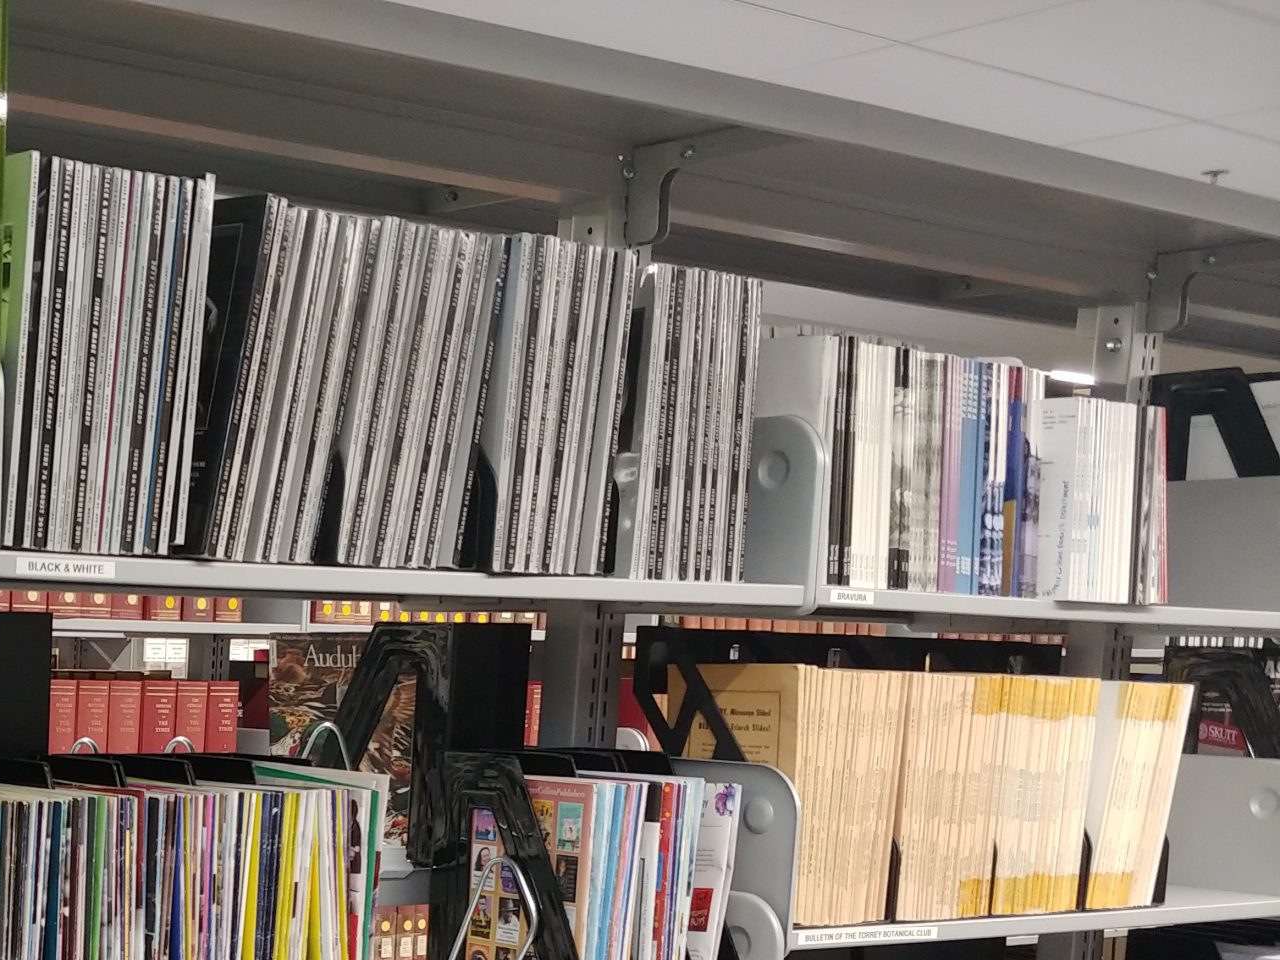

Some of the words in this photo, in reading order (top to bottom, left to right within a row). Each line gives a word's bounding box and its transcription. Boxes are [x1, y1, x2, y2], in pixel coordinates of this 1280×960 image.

[64, 165, 72, 191] BLACK
[103, 174, 112, 198] BLACK
[60, 201, 70, 226] WHITE
[100, 208, 108, 234] WHITE
[57, 229, 67, 272] MAGAZINE
[96, 236, 106, 278] MAGAZINE
[54, 288, 62, 308] 2010
[147, 283, 155, 309] COLOR
[92, 297, 101, 326] SINGLE
[51, 311, 62, 356] PORTFOLIO
[90, 327, 98, 353] IMAGE
[142, 311, 153, 354] PORTFOLIO
[48, 359, 57, 394] CONTEST
[87, 356, 96, 391] CONTEST
[139, 357, 150, 390] CONTEST
[45, 395, 54, 429] AWARDS
[84, 393, 93, 426] AWARDS
[136, 393, 146, 424] AWARDS
[42, 444, 50, 466] ISSUE
[132, 449, 140, 471] ISSUE
[38, 482, 47, 514] AUGUST
[76, 482, 86, 522] FEBRUARY
[127, 487, 137, 522] OCTOBER
[153, 479, 164, 518] FEBRUARY
[36, 516, 44, 538] 2010
[74, 525, 82, 544] 2011
[28, 561, 61, 572] BLACK
[64, 564, 70, 572] &
[72, 564, 104, 574] WHITE
[837, 592, 868, 602] BRAVURA
[1208, 725, 1237, 741] SKUTT
[805, 933, 834, 942] BULLETIN
[845, 932, 856, 940] THE
[858, 931, 881, 939] TORREY
[883, 930, 915, 938] BOTANICAL
